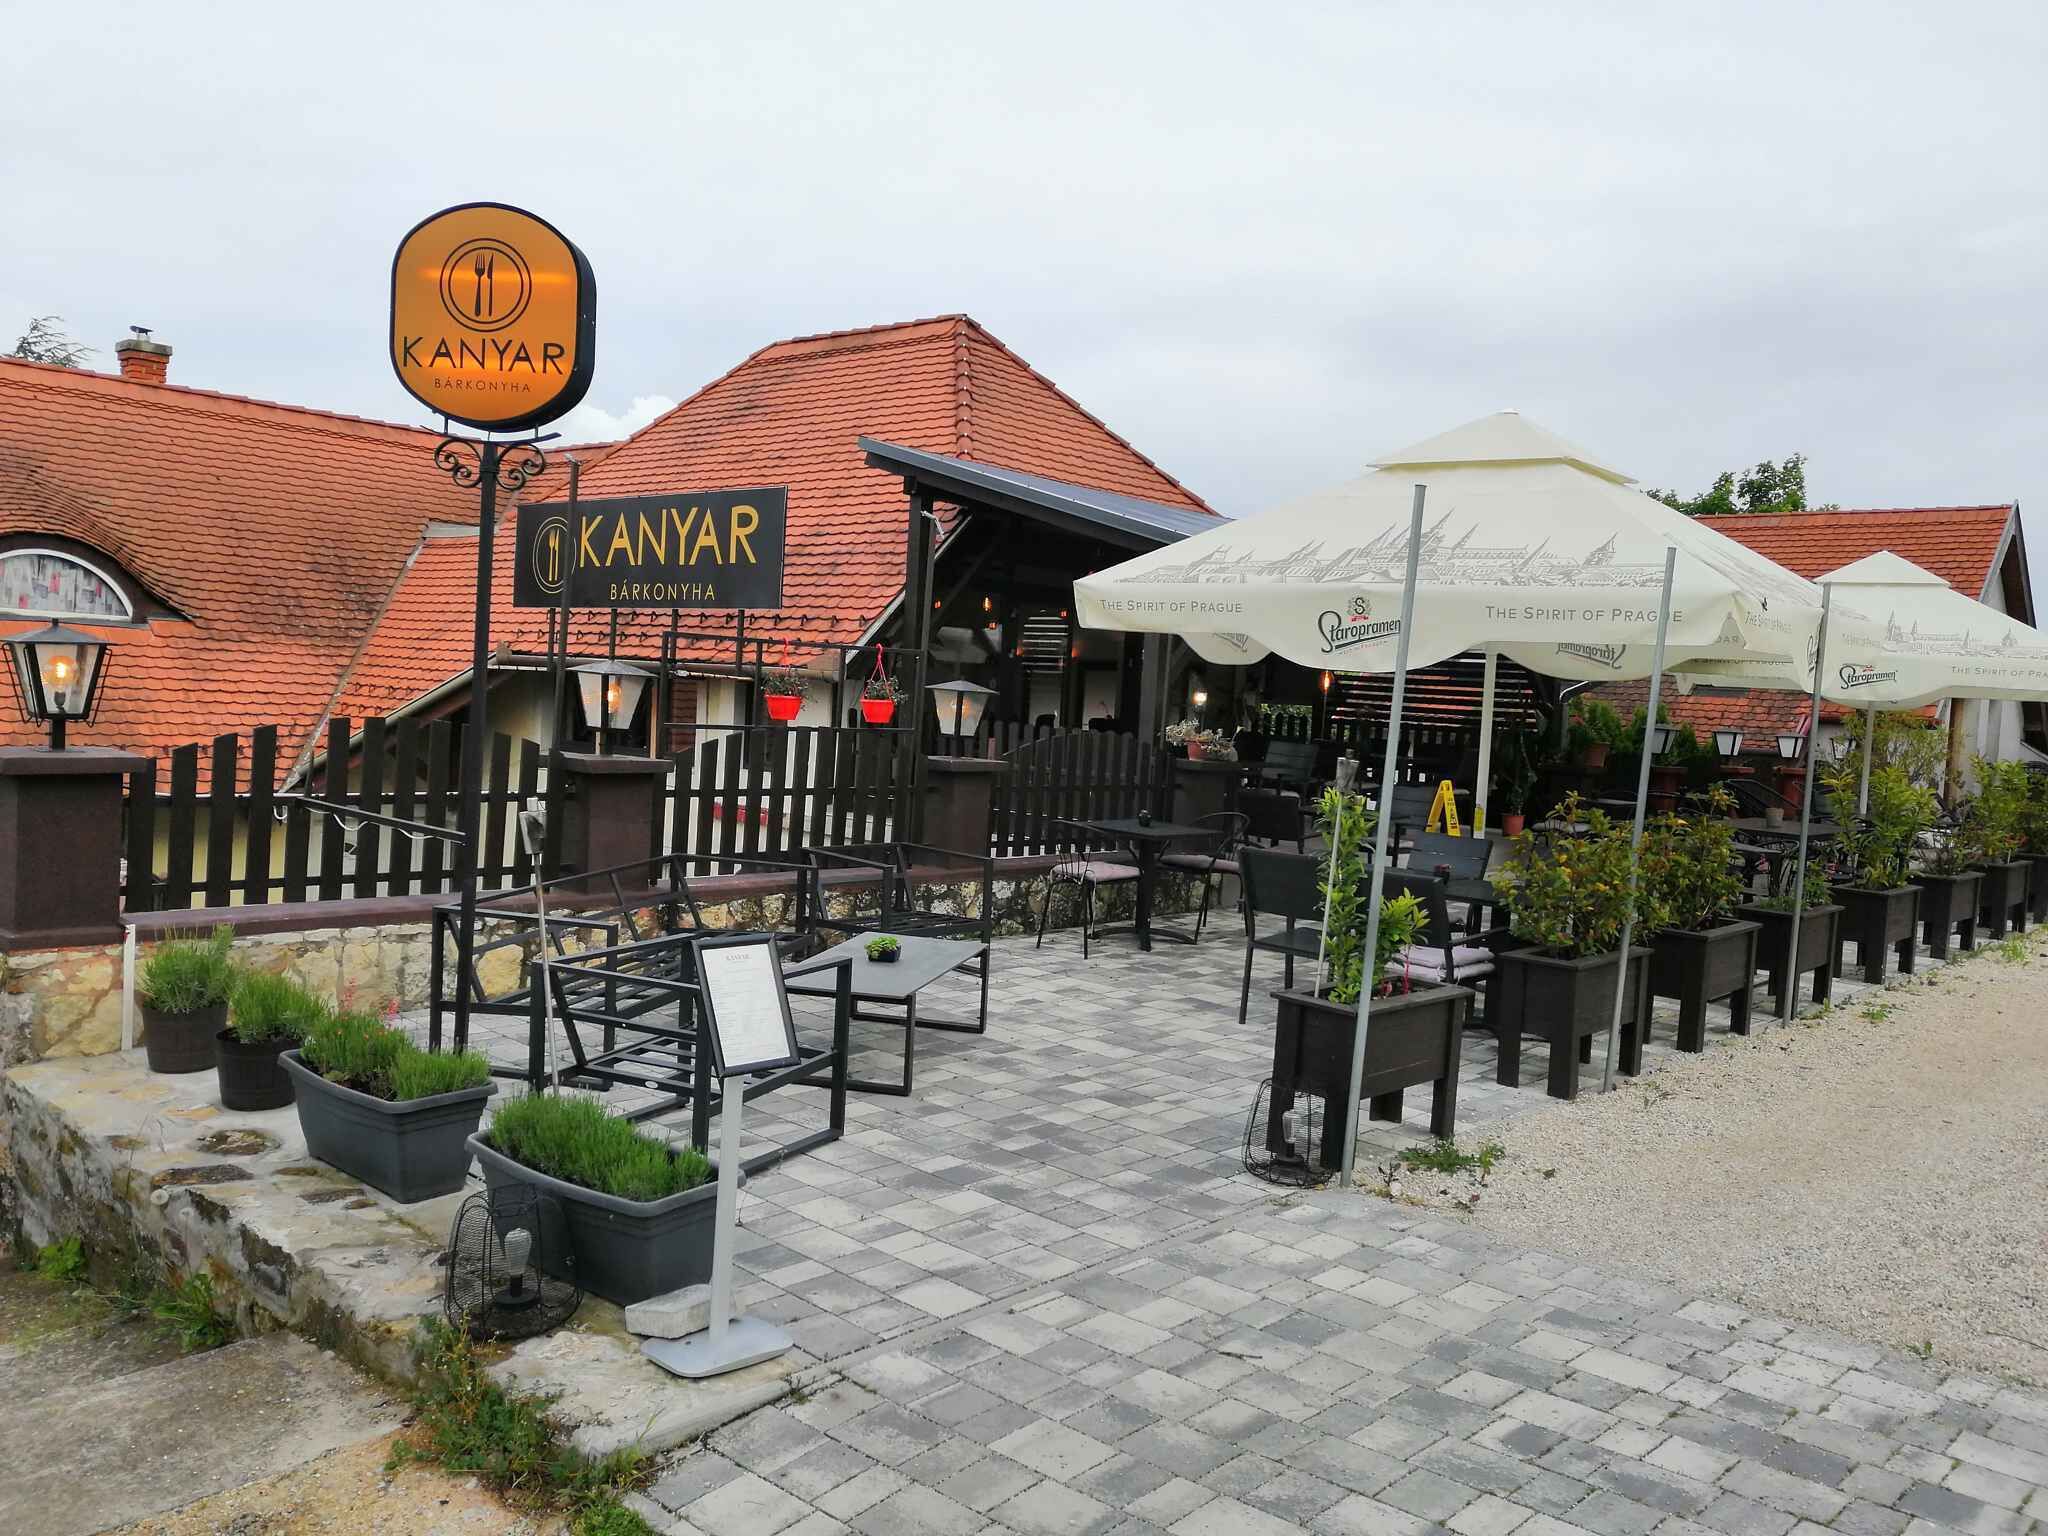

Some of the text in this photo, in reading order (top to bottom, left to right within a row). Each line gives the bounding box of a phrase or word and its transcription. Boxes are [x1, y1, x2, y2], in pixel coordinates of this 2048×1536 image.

[402, 335, 566, 376] KANYAR
[433, 376, 532, 393] BÁRKONYHA
[579, 504, 760, 568] KANYAR
[610, 578, 716, 601] BÁRKONYHA
[1611, 608, 1683, 623] PRAGE
[1317, 610, 1401, 654] Staropramen
[1839, 664, 1898, 690] Staropramen
